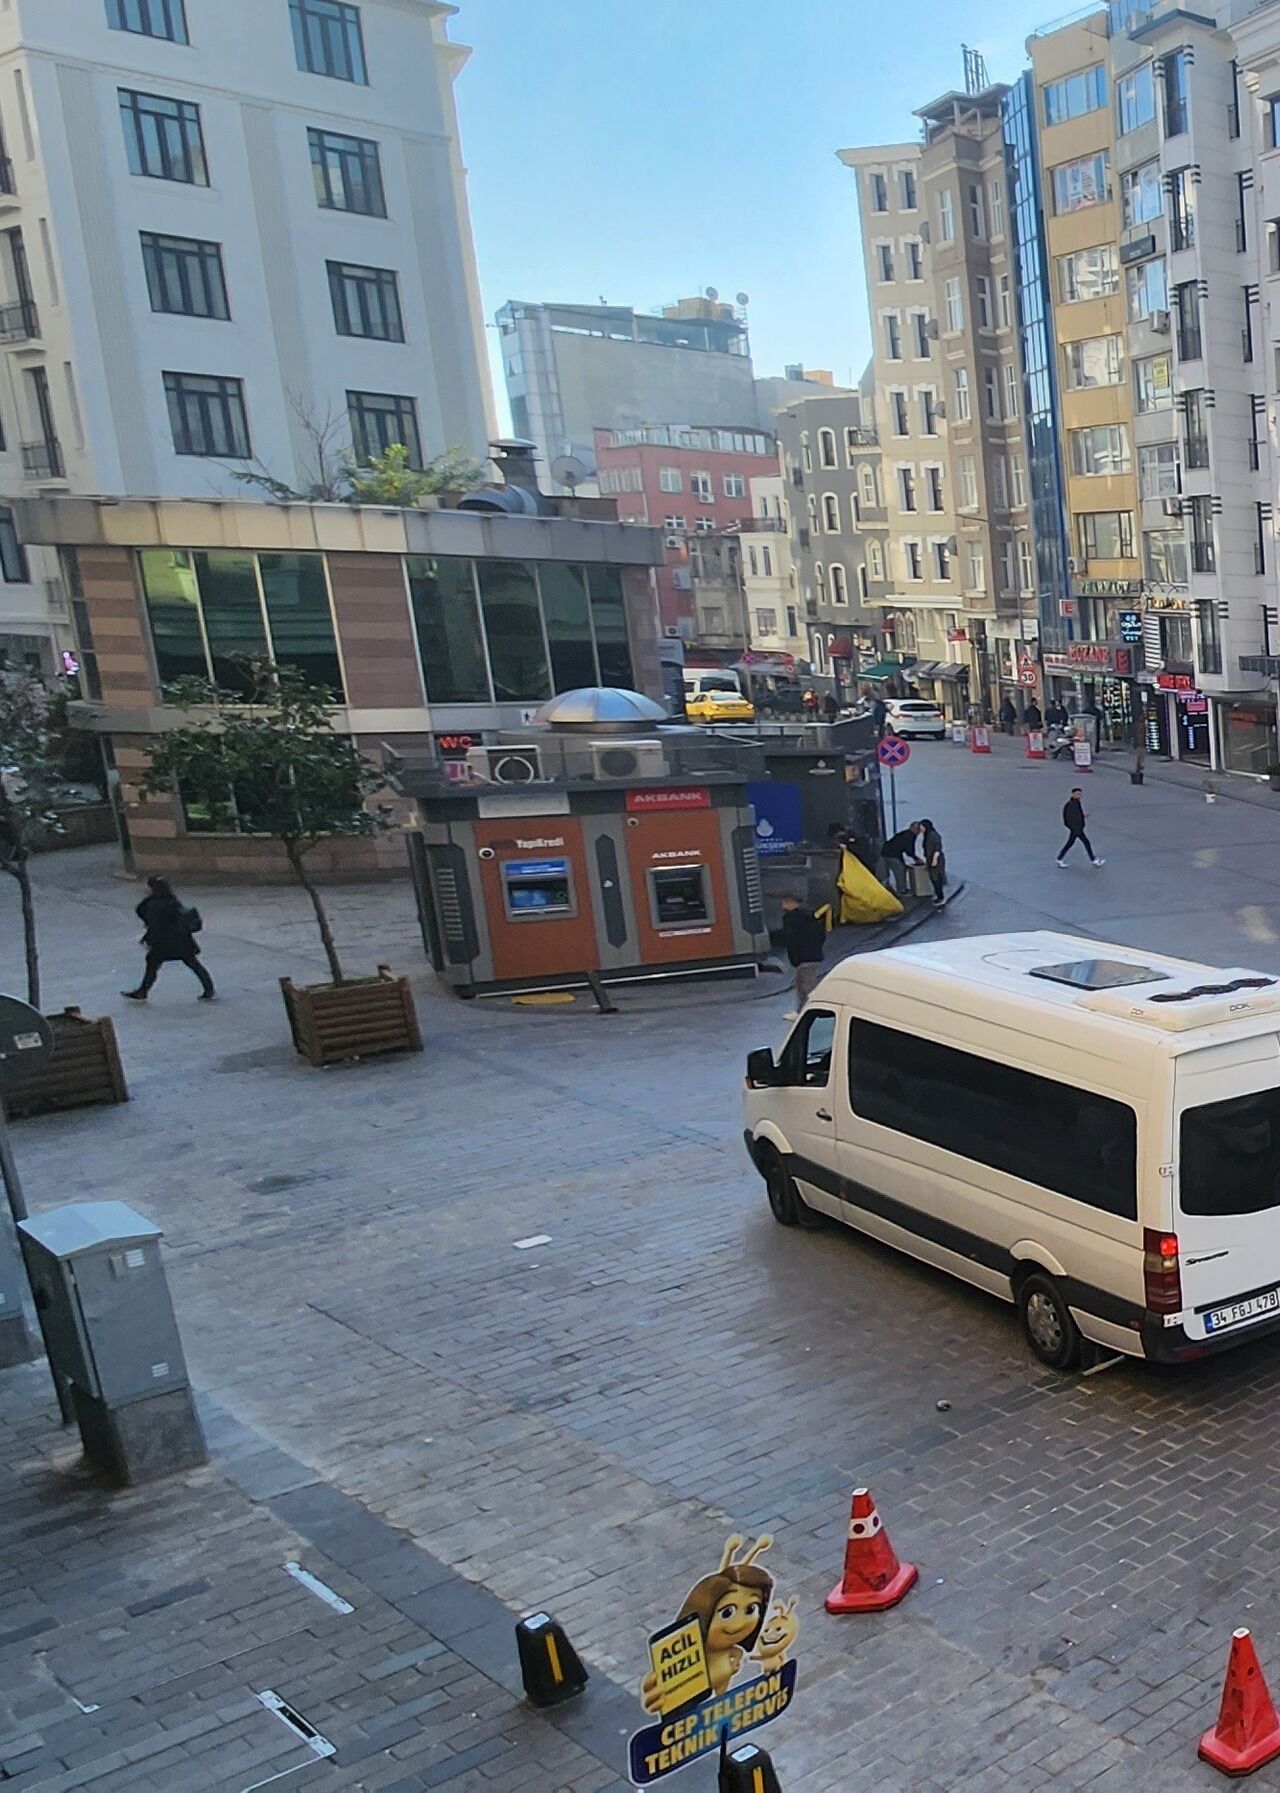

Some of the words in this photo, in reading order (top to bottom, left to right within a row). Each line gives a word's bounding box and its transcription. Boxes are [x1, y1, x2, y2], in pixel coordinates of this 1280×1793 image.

[1023, 673, 1034, 682] 30
[439, 735, 472, 749] WC
[633, 791, 703, 804] AKBANK
[651, 849, 701, 859] AKBANK
[1212, 1311, 1227, 1326] 34
[1231, 1304, 1252, 1319] FGJ
[1256, 1292, 1277, 1311] 478
[660, 1632, 697, 1664] ACİL
[661, 1650, 702, 1683] HIZLI
[661, 1713, 699, 1747] CEP
[702, 1674, 781, 1725] TELEFON
[645, 1723, 718, 1775] TEKNİK
[731, 1686, 788, 1732] SERVİS
